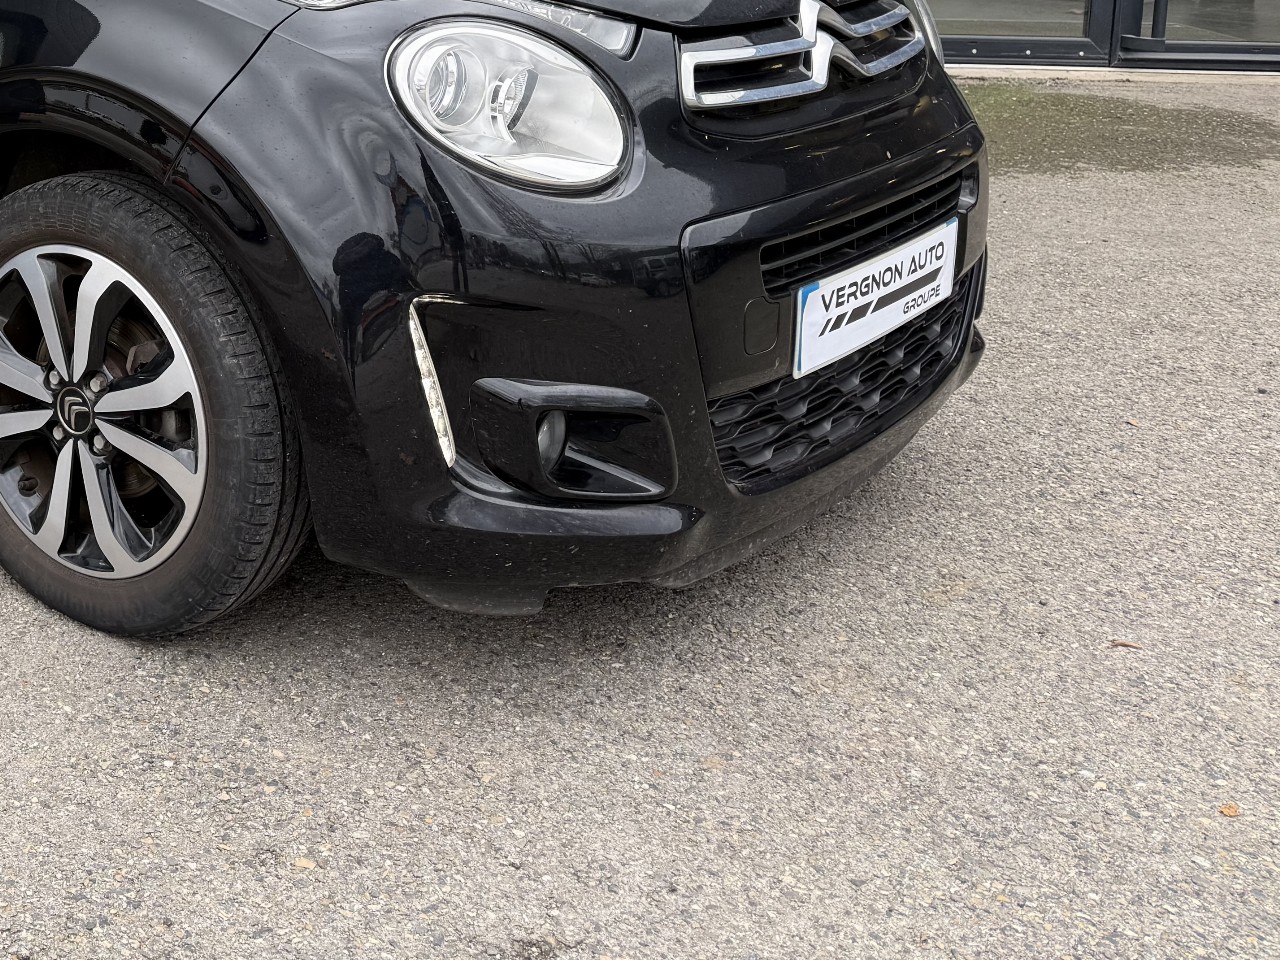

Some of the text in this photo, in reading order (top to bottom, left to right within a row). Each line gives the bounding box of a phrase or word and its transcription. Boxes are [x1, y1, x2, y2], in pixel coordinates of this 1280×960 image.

[821, 241, 945, 313] VERGNON AUTO
[902, 283, 941, 315] GROUPE
